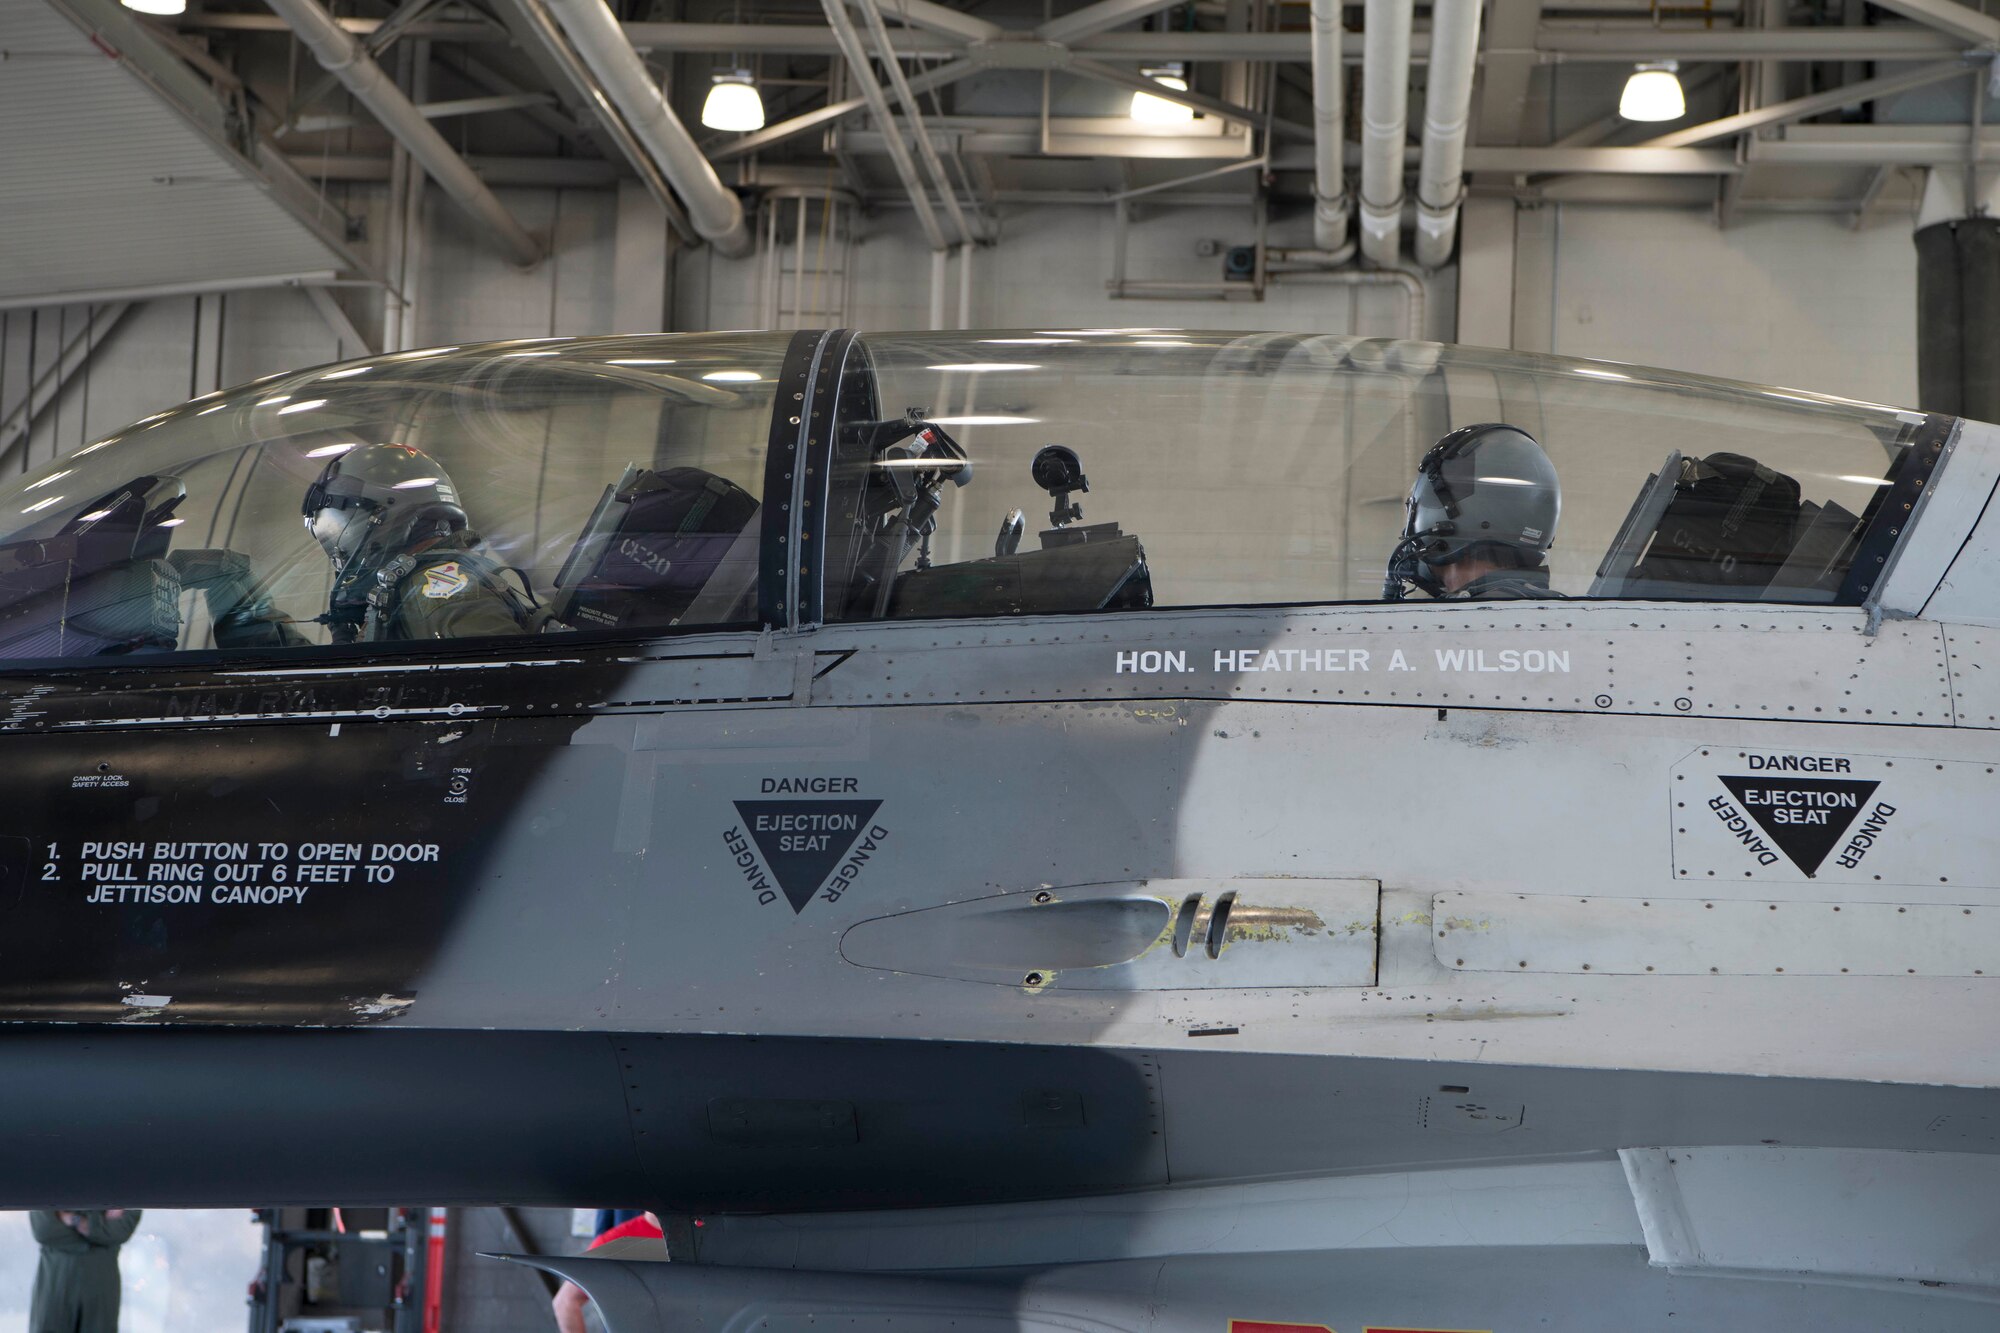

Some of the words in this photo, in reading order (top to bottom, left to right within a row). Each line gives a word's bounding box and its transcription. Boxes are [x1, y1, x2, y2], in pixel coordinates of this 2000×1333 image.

[1115, 650, 1195, 673] HON.
[1213, 649, 1370, 672] HEATHER
[1387, 649, 1417, 672] A.
[1435, 649, 1571, 673] WILSON
[1748, 755, 1852, 773] DANGER
[761, 777, 858, 793] DANGER
[1744, 789, 1857, 807] EJECTION
[756, 814, 857, 831] EJECTION
[1773, 808, 1831, 824] SEAT
[1707, 795, 1779, 866] DANGER
[1835, 801, 1897, 870] DANGER
[46, 842, 61, 860] 1.
[81, 842, 145, 860] PUSH
[153, 842, 249, 860] BUTTON
[258, 842, 289, 861] TO
[298, 842, 362, 861] OPEN
[371, 843, 440, 862] DOOR
[779, 835, 831, 852] SEAT
[41, 863, 61, 881] 2.
[81, 863, 138, 881] PULL
[147, 863, 204, 882] RING
[213, 863, 264, 882] OUT
[271, 864, 288, 882] 6
[296, 864, 356, 883] FEET
[364, 864, 395, 883] TO
[722, 825, 778, 906] DANGER
[820, 824, 889, 903] DANGER
[86, 884, 202, 903] JETTISON
[211, 885, 309, 904] CANOPY
